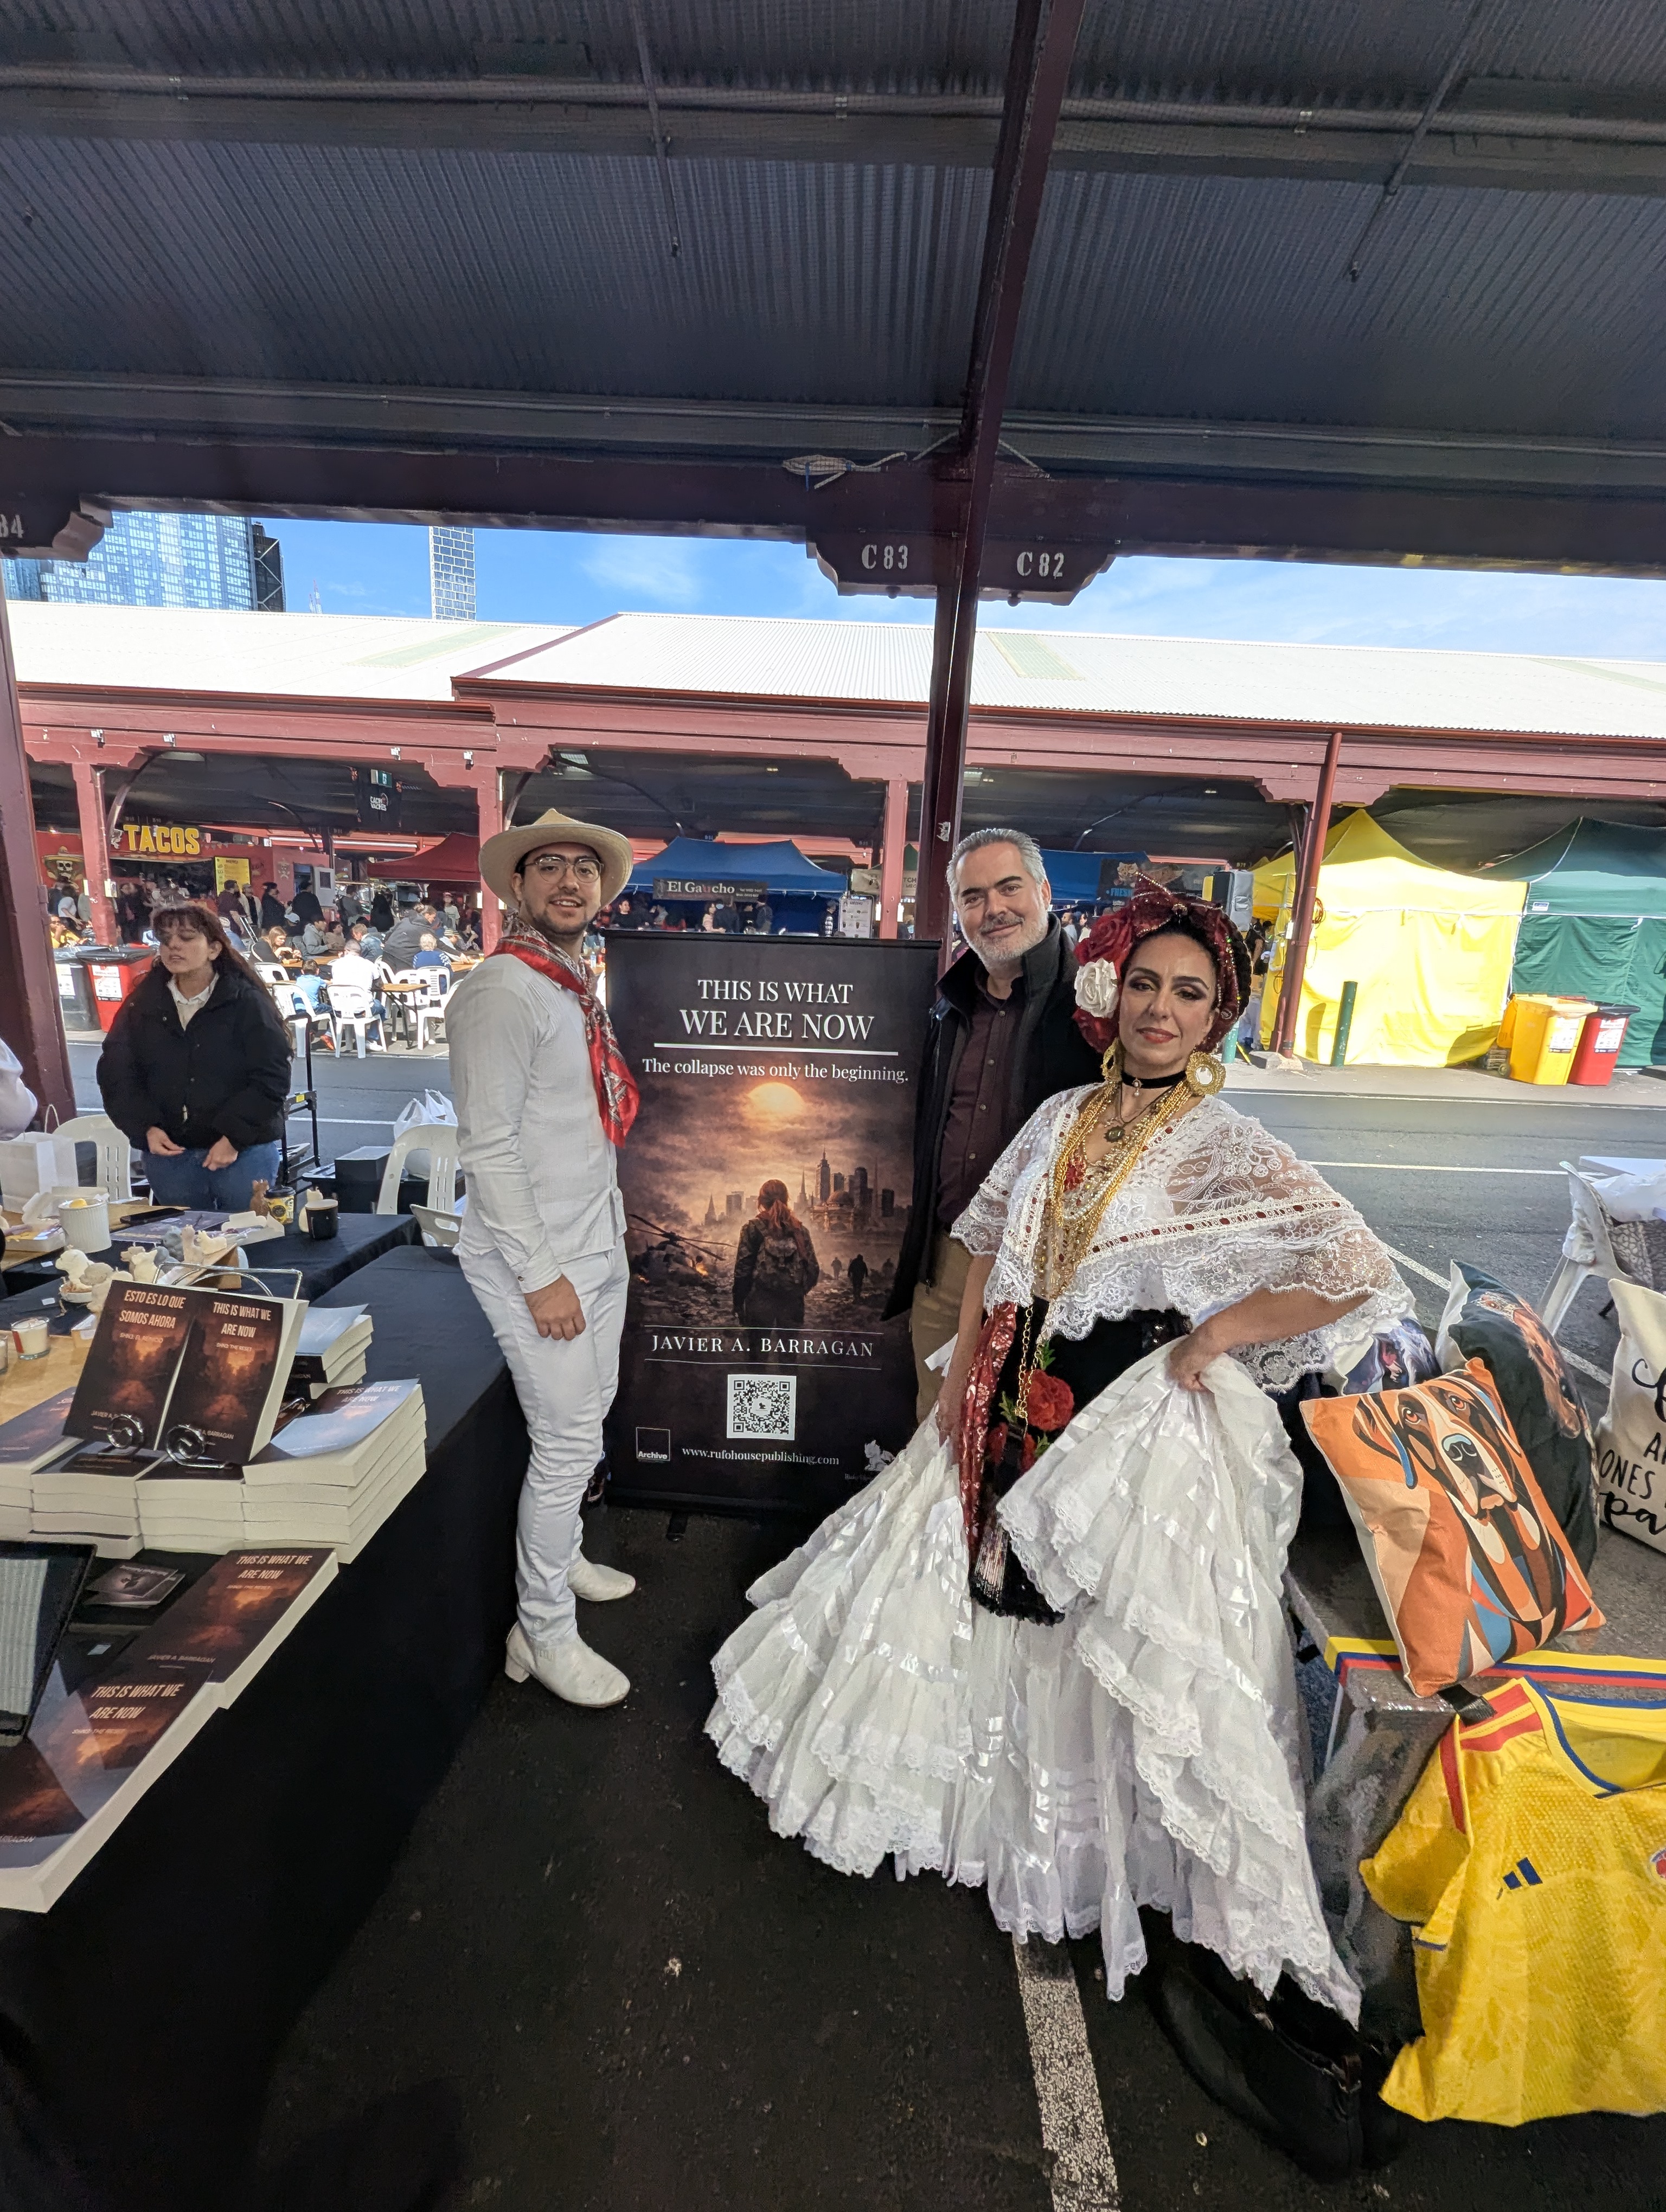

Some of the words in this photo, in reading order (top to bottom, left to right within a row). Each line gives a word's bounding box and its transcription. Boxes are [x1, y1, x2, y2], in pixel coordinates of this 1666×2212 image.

[123, 824, 200, 854] TACOS
[667, 880, 681, 892] El
[684, 882, 735, 893] Gaucho
[698, 979, 752, 1002] THIS
[758, 982, 779, 1002] IS
[785, 982, 853, 1005] WHAT
[680, 1009, 728, 1036] WE
[733, 1011, 792, 1038] ARE
[802, 1013, 875, 1041] NOW
[643, 1058, 670, 1075] The
[674, 1059, 734, 1078] collapse
[738, 1064, 765, 1077] was
[769, 1062, 801, 1081] only
[804, 1064, 828, 1079] the
[832, 1065, 908, 1084] beginning.
[124, 1290, 146, 1303] ESTO
[145, 1293, 158, 1304] ES
[157, 1295, 169, 1306] LO
[169, 1296, 186, 1309] QUE
[119, 1310, 149, 1324] SOMOS
[148, 1314, 176, 1329] AHORA
[213, 1302, 230, 1315] THIS
[230, 1304, 239, 1316] IS
[239, 1306, 260, 1319] WHAT
[260, 1309, 272, 1321] WE
[221, 1323, 238, 1335] ARE
[238, 1325, 256, 1338] NOW
[651, 1334, 723, 1352] JAVIER
[731, 1336, 750, 1352] A.
[761, 1338, 873, 1356] BARRAGAN
[638, 1450, 668, 1461] Archive
[682, 1446, 840, 1465] www.rufohousepublishing.com
[1600, 1449, 1655, 1500] ONES
[236, 1555, 259, 1564] THIS
[257, 1555, 269, 1564] IS
[267, 1555, 297, 1564] WHAT
[294, 1555, 313, 1564] WE
[238, 1570, 260, 1579] ARE
[257, 1570, 284, 1579] NOW
[91, 1686, 119, 1697] THIS
[116, 1686, 132, 1697] IS
[128, 1684, 165, 1697] WHAT
[161, 1684, 184, 1697] WE
[89, 1707, 118, 1719] ARE
[112, 1707, 146, 1719] NOW
